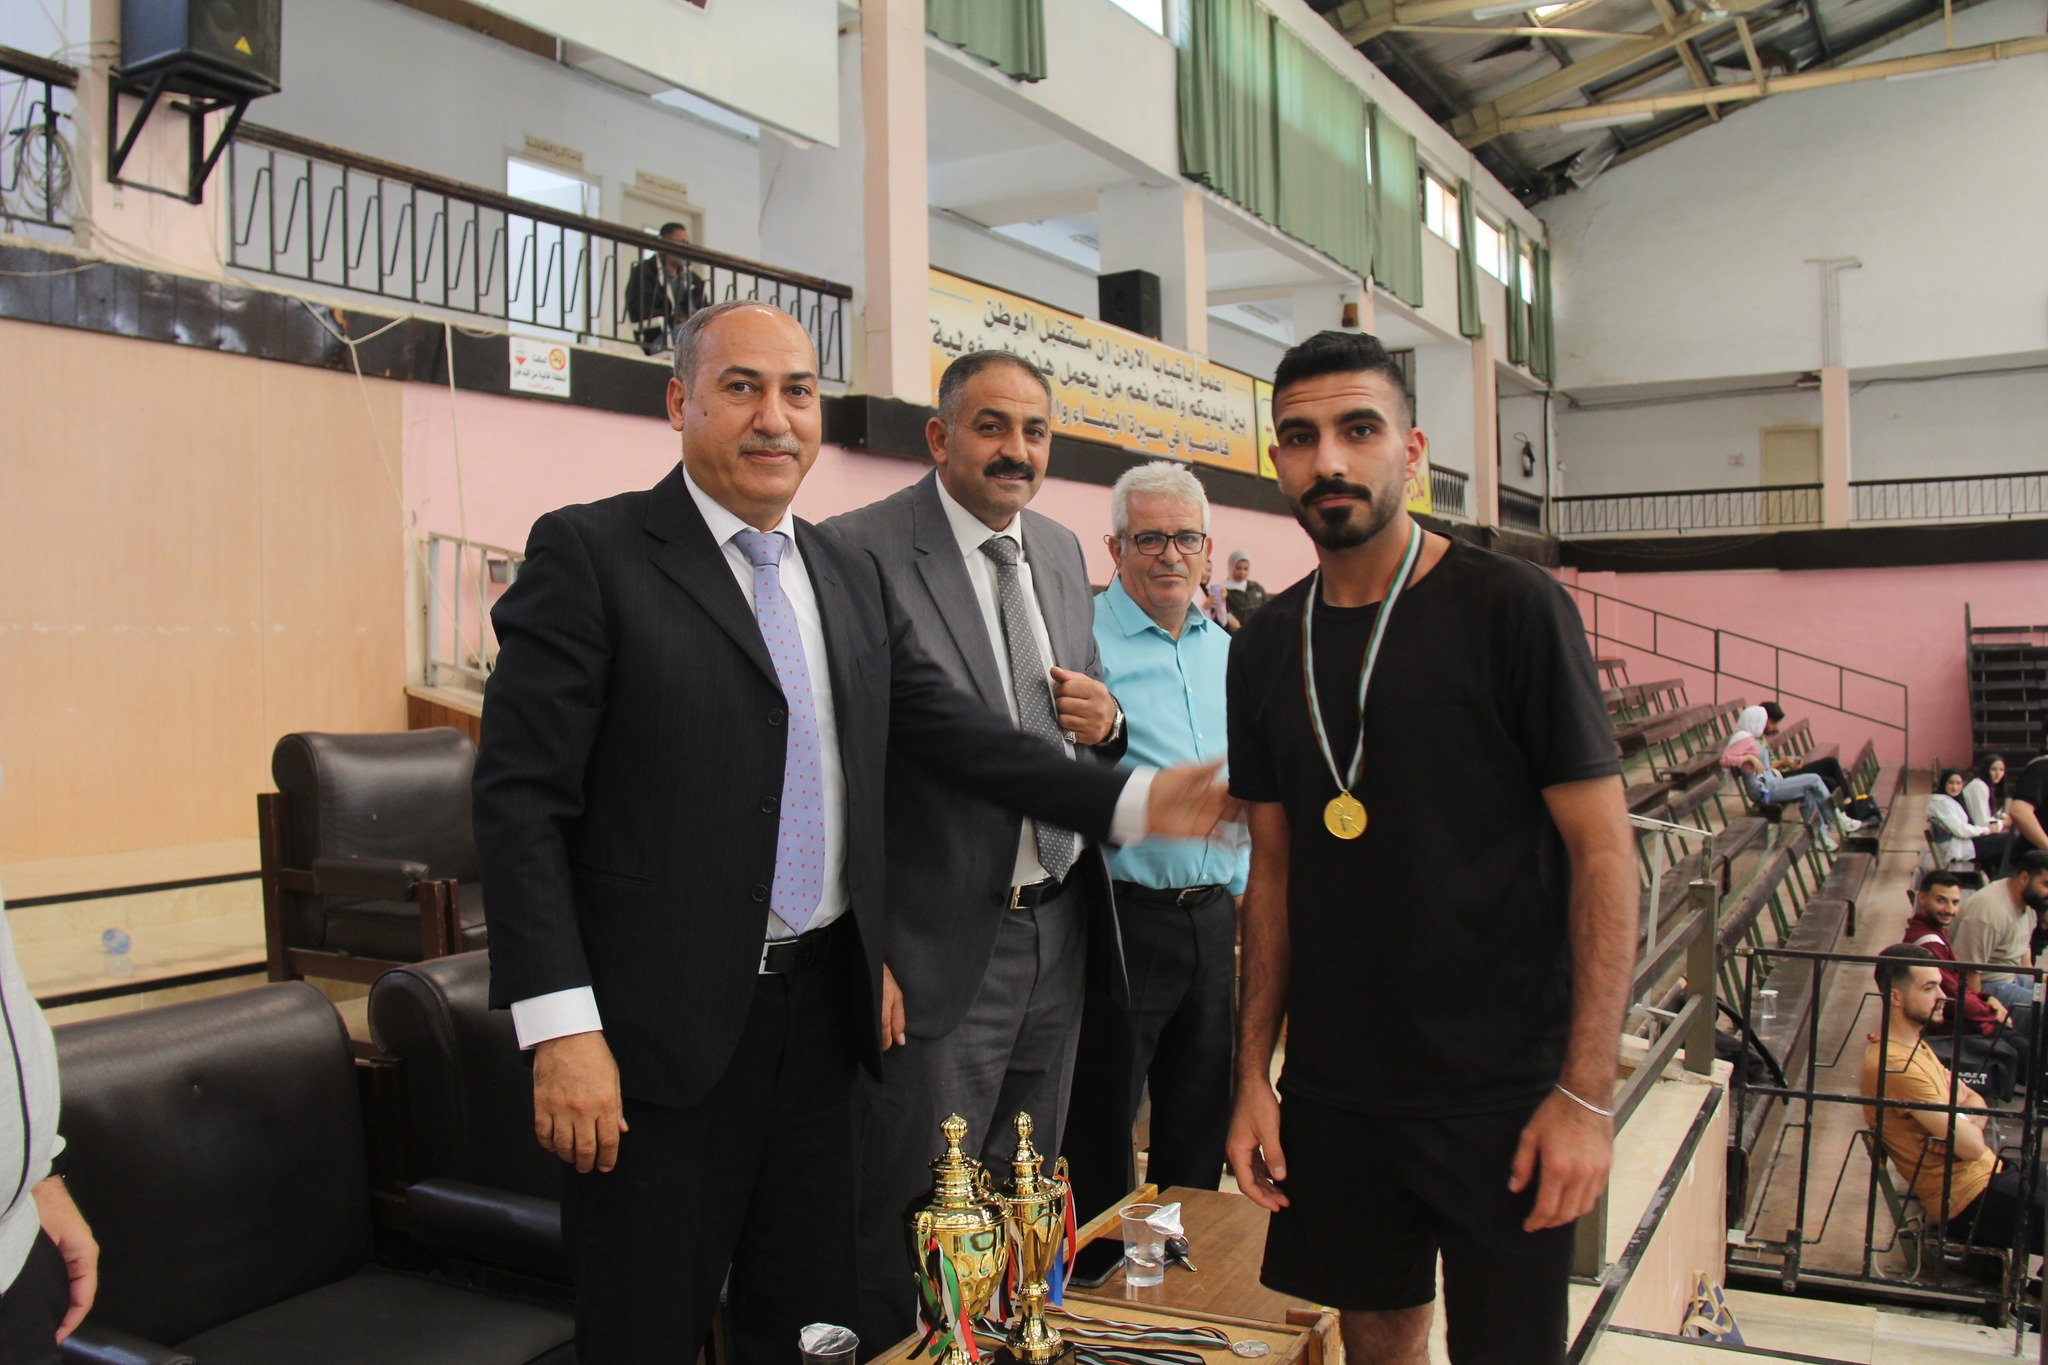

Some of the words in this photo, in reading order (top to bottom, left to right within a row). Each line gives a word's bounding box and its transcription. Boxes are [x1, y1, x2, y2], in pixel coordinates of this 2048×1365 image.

[984, 300, 1035, 335] الوطن
[1039, 319, 1092, 350] مستقبل
[1060, 361, 1099, 395] يحمل
[1105, 374, 1122, 398] من
[1127, 382, 1149, 404] نعم
[1072, 403, 1126, 437] البناء
[1128, 414, 1164, 445] مسيرة
[1230, 409, 1246, 437] بين
[1167, 424, 1181, 454] في
